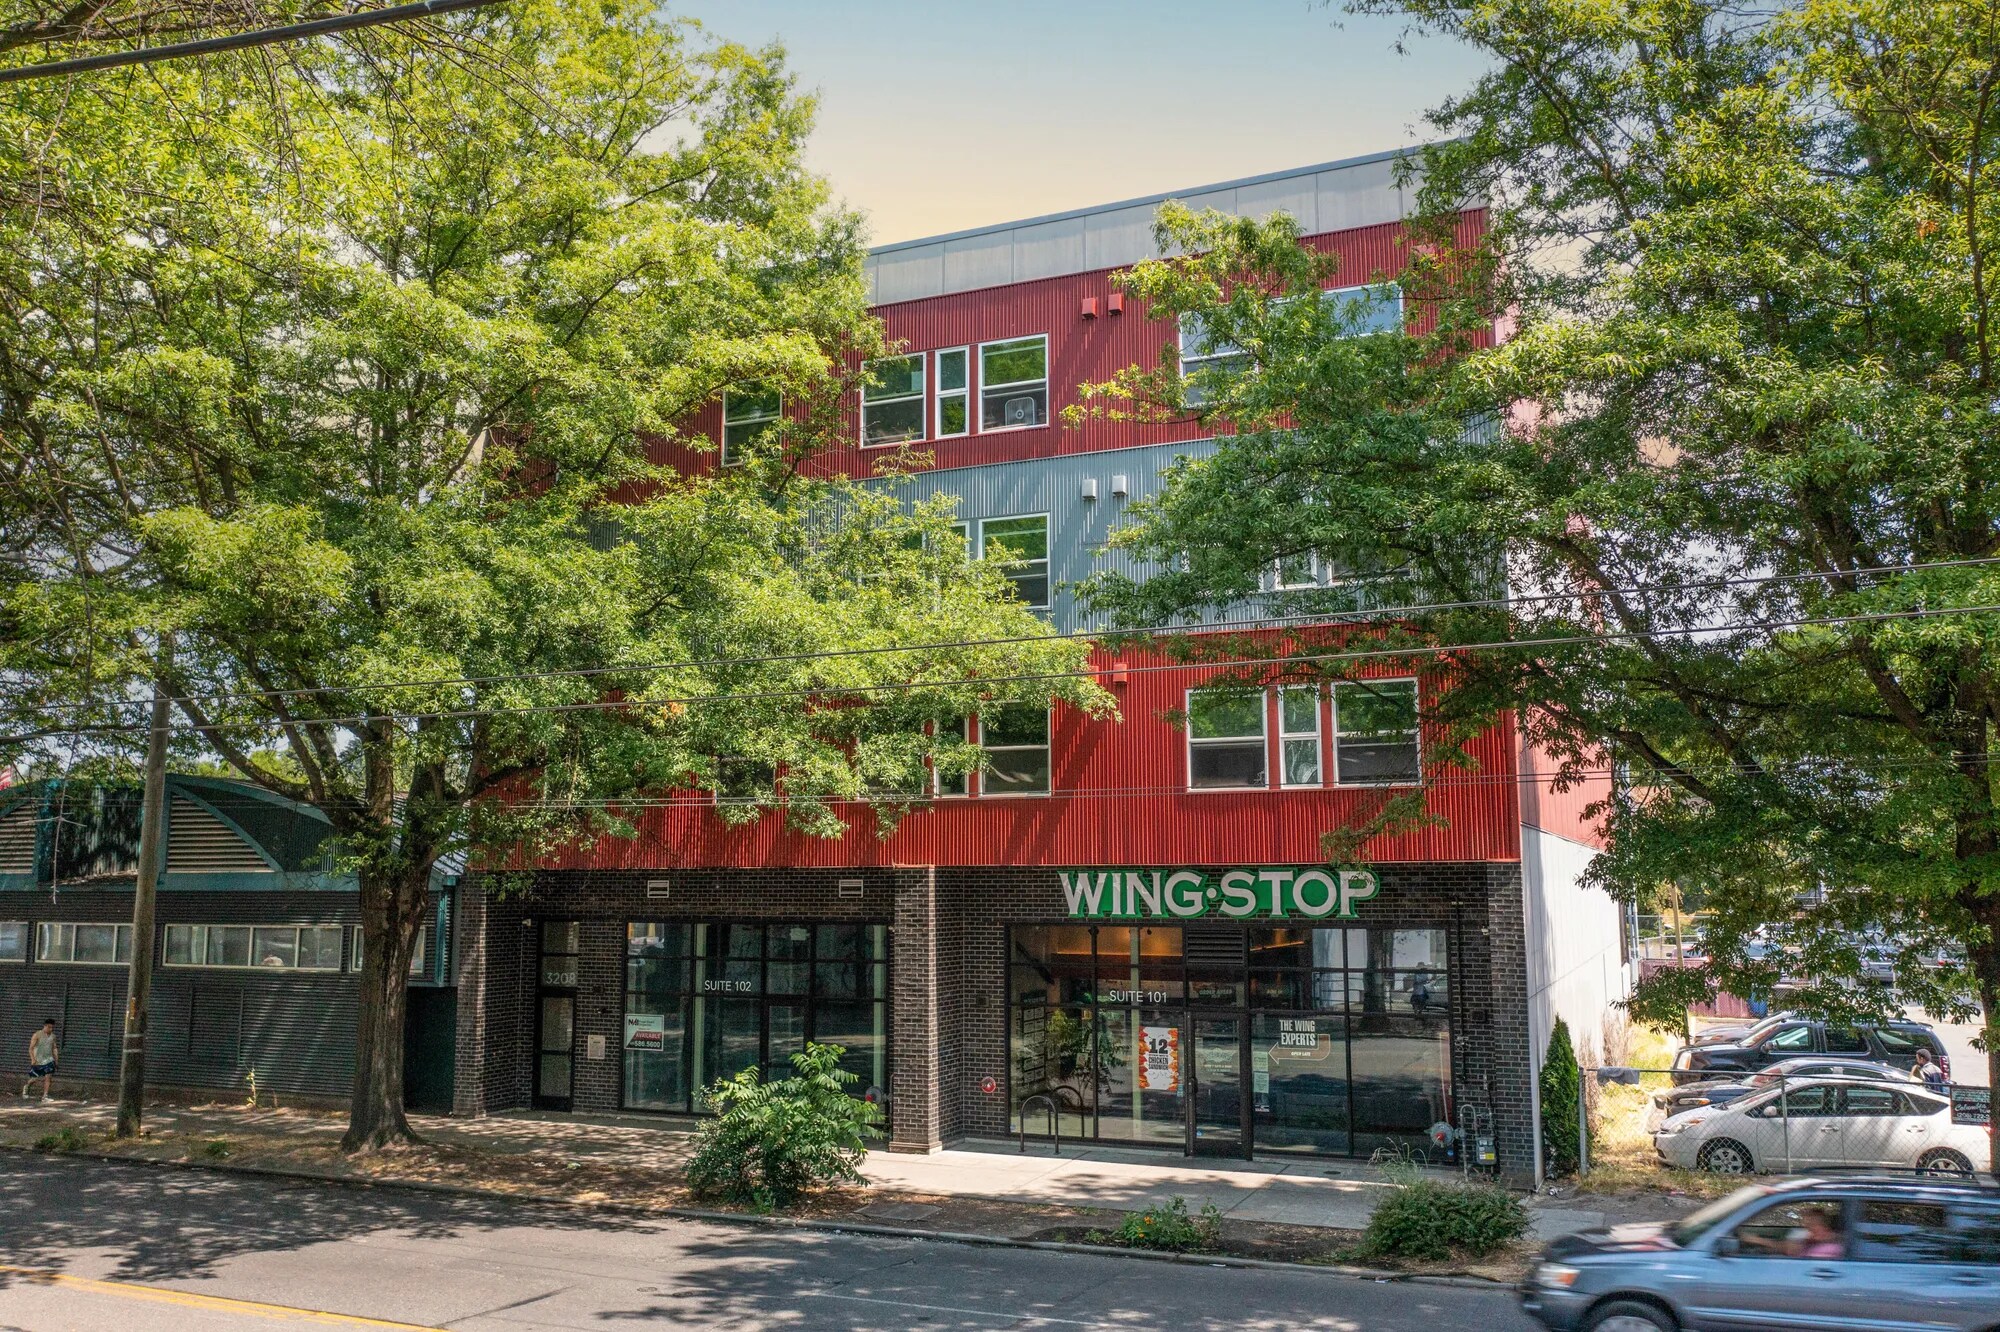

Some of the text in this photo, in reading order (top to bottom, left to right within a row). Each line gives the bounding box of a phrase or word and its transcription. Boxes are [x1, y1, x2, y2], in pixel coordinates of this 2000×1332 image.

[545, 972, 576, 985] 3208
[704, 980, 752, 993] SUITE 102
[1109, 990, 1168, 1003] SUITE 101
[1279, 1019, 1316, 1032] THE WING
[635, 1032, 661, 1040] AVAILABLE
[1281, 1033, 1316, 1047] EXPERTS
[1149, 1038, 1168, 1055] 12
